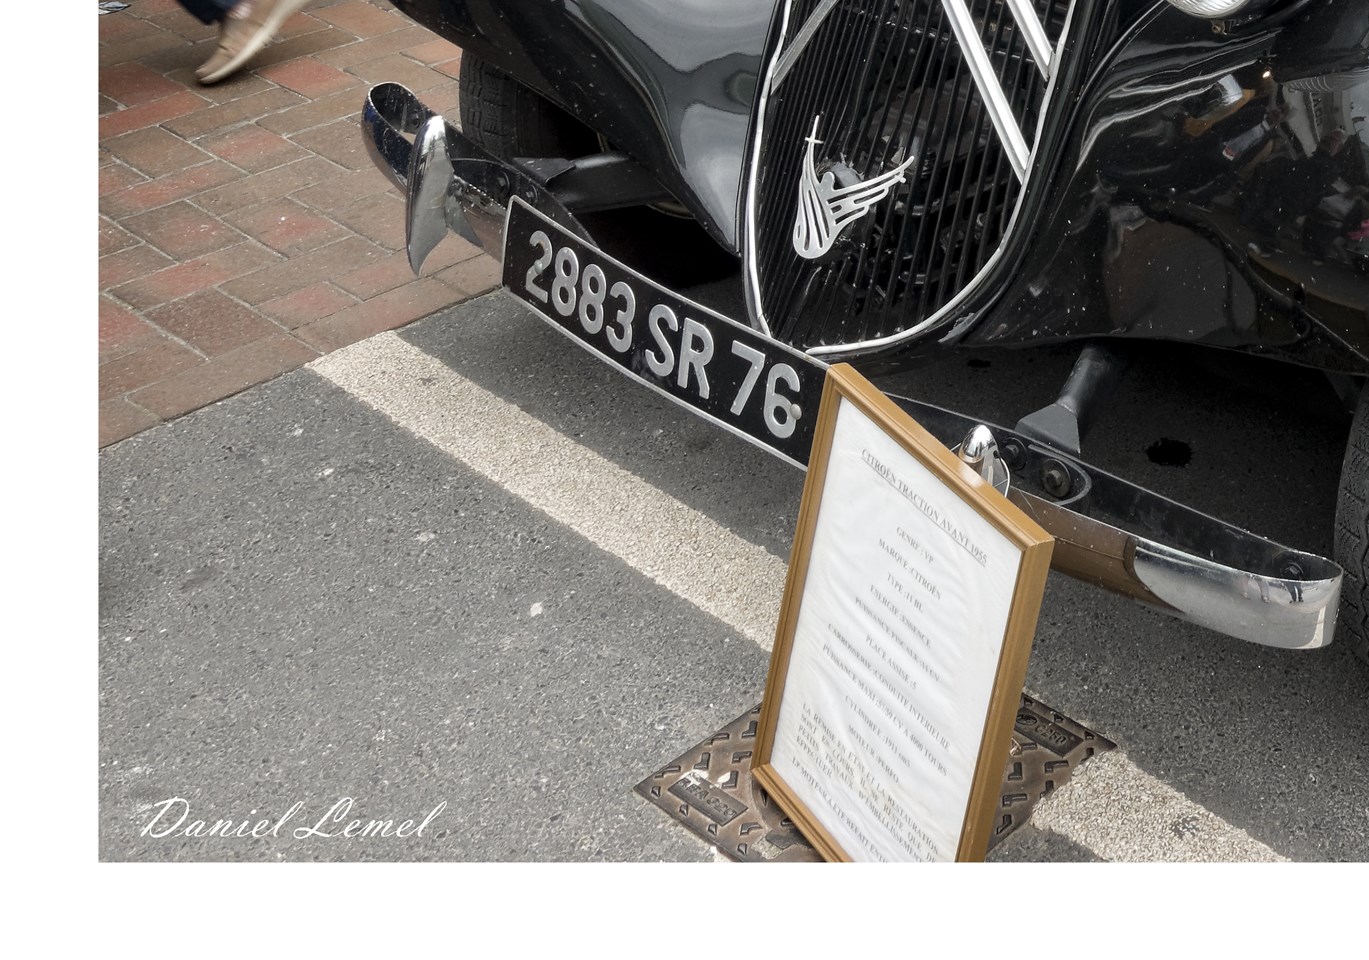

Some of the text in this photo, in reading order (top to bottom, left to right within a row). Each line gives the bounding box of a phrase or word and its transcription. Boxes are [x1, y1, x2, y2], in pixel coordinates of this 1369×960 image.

[526, 230, 802, 439] 2883 SR 76
[896, 525, 920, 553] GENRE
[897, 478, 939, 522] TRACTION
[941, 516, 968, 548] AVANT
[970, 543, 987, 565] 1955
[878, 537, 908, 571] MARQUE
[886, 572, 903, 593] TYPE
[865, 633, 886, 661] PLACE
[887, 655, 909, 684] ASSISE
[848, 723, 875, 758] MOTEUR
[857, 678, 875, 703] MAXI
[923, 746, 946, 778] TOURS
[908, 702, 949, 752] INTERIEURE
[883, 803, 903, 831] RESTE
[887, 792, 938, 858] RESTAURATION
